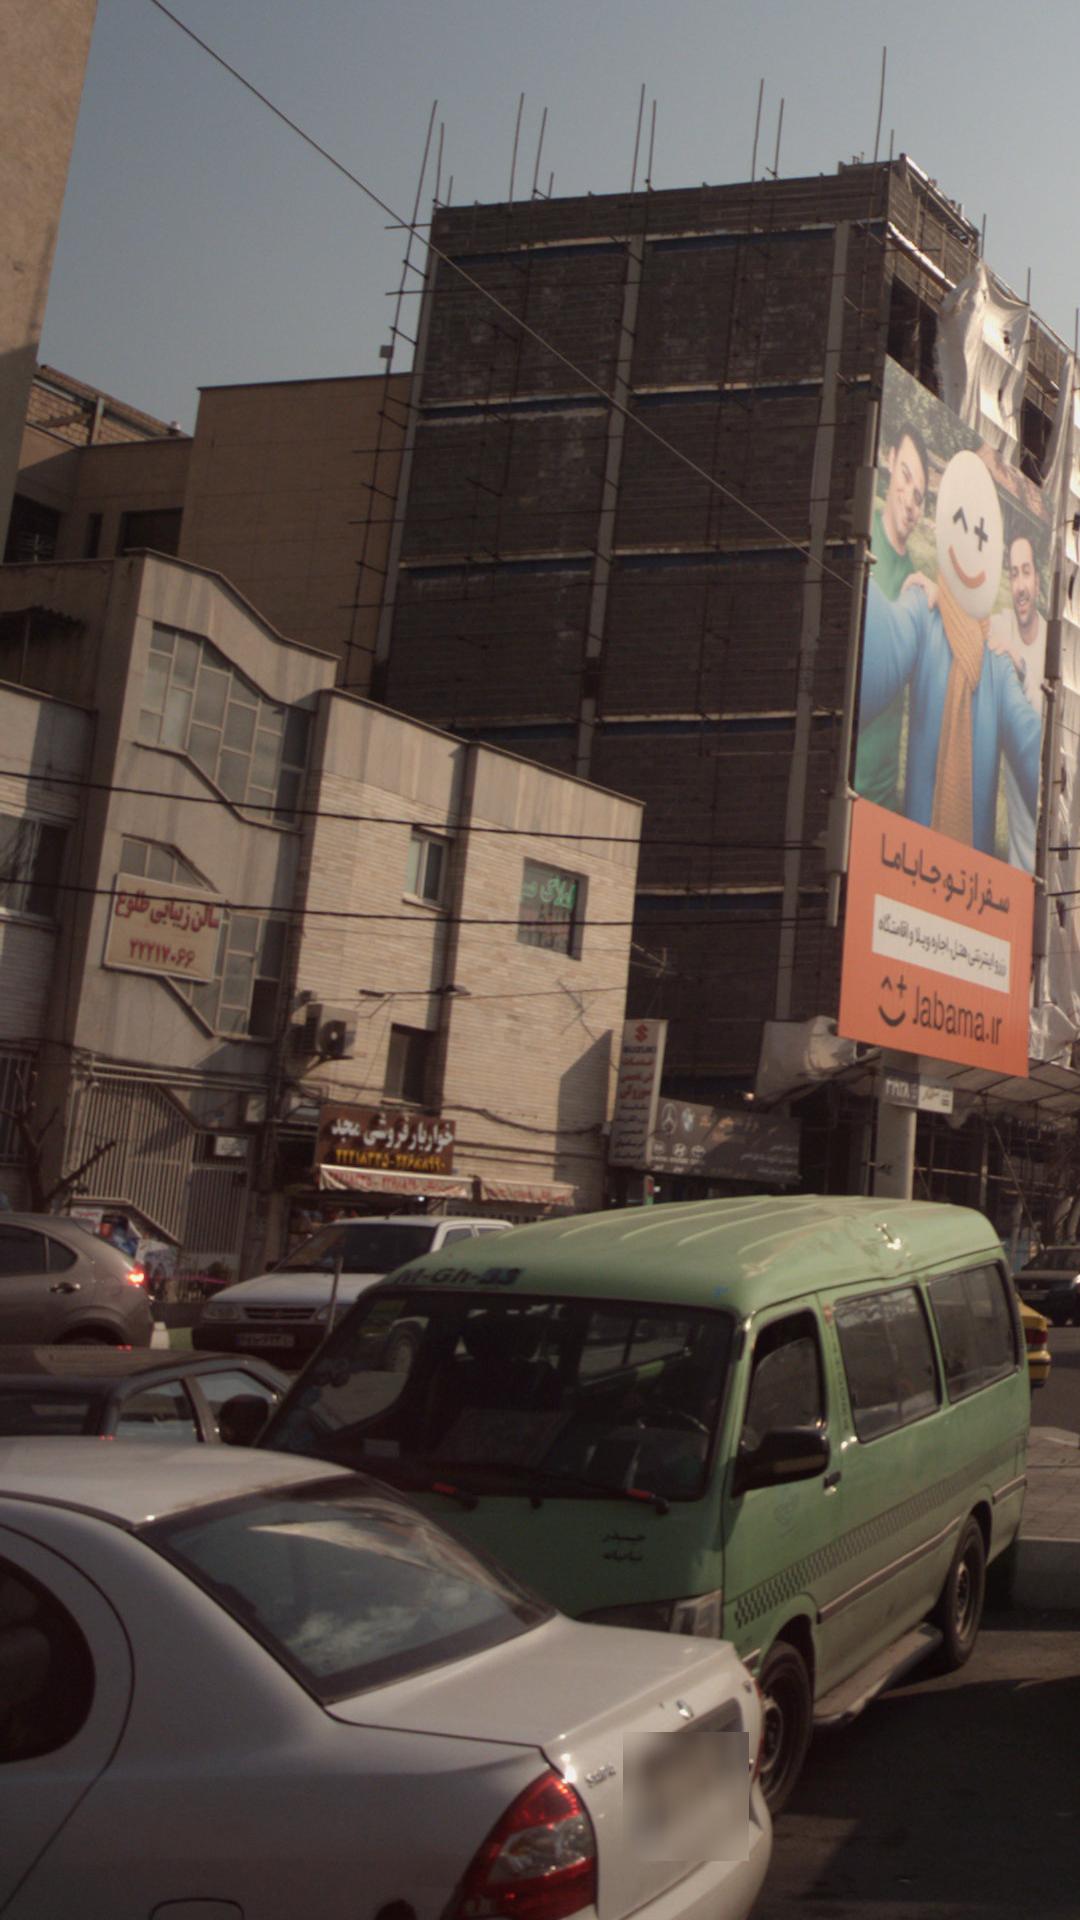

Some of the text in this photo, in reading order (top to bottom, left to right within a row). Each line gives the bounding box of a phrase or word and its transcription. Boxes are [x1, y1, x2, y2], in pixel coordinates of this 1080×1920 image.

[944, 869, 966, 901] تو
[977, 878, 1009, 914] سفر
[114, 889, 219, 932] سالن زیبایی طلوع
[878, 912, 909, 938] اقامتگاه
